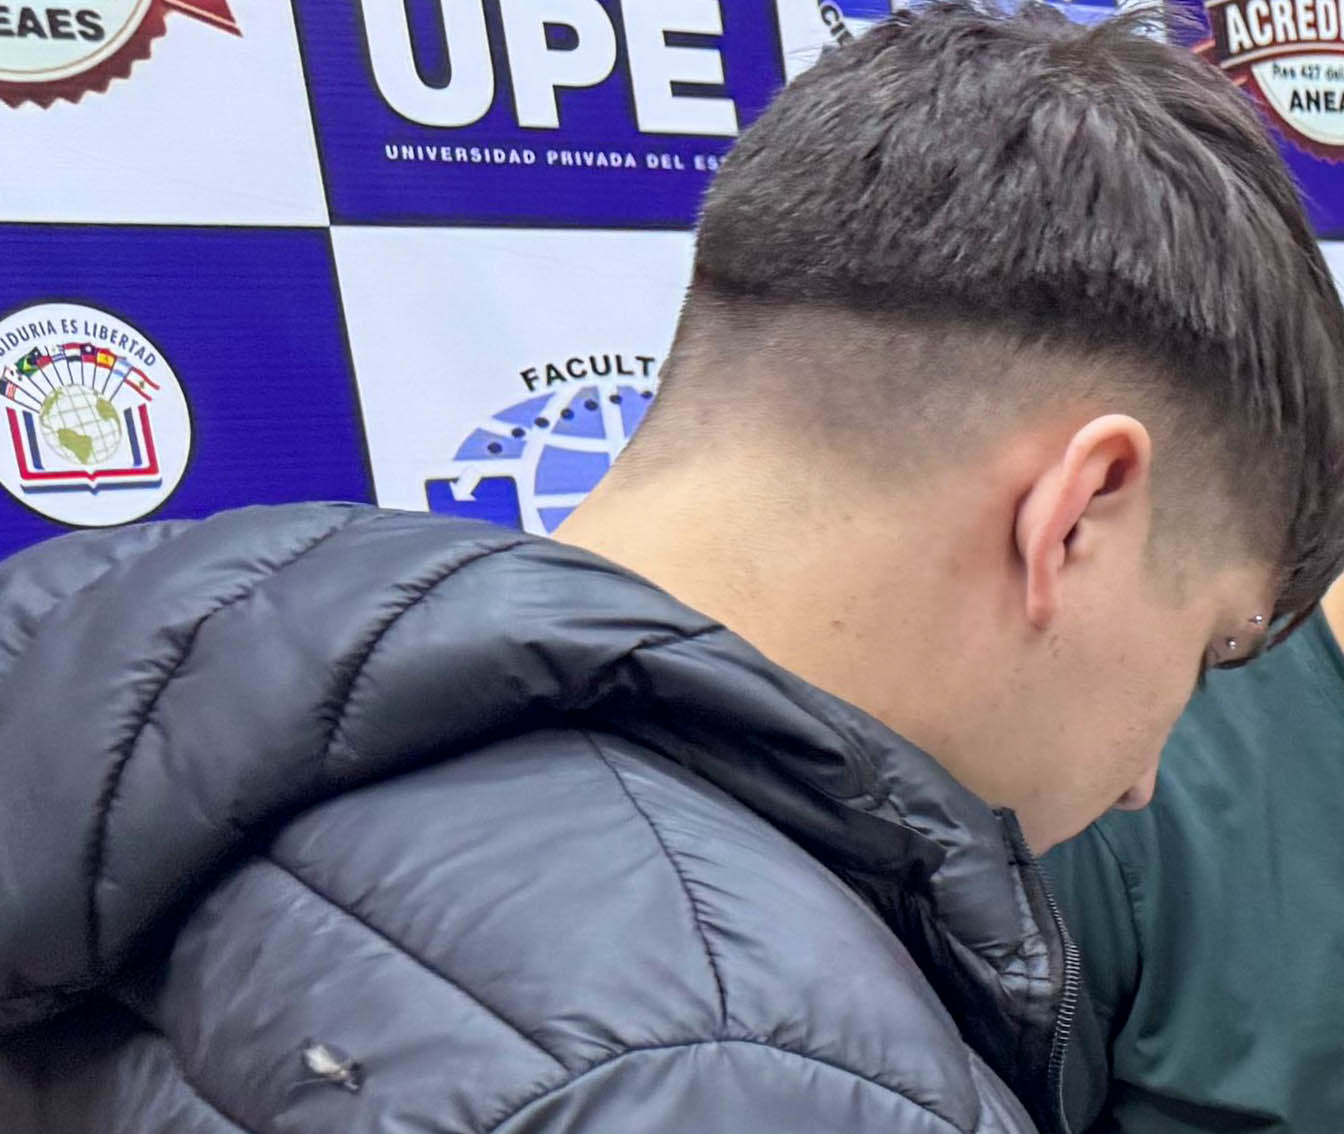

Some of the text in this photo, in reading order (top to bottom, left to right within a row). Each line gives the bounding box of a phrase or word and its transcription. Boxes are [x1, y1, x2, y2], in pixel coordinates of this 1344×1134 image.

[361, 0, 740, 137] UPE
[384, 144, 536, 165] UNIVERSIDAD
[547, 149, 638, 169] PRIVADA
[646, 154, 685, 171] DEL
[61, 319, 79, 335] ES
[84, 320, 157, 367] LIBERTAD
